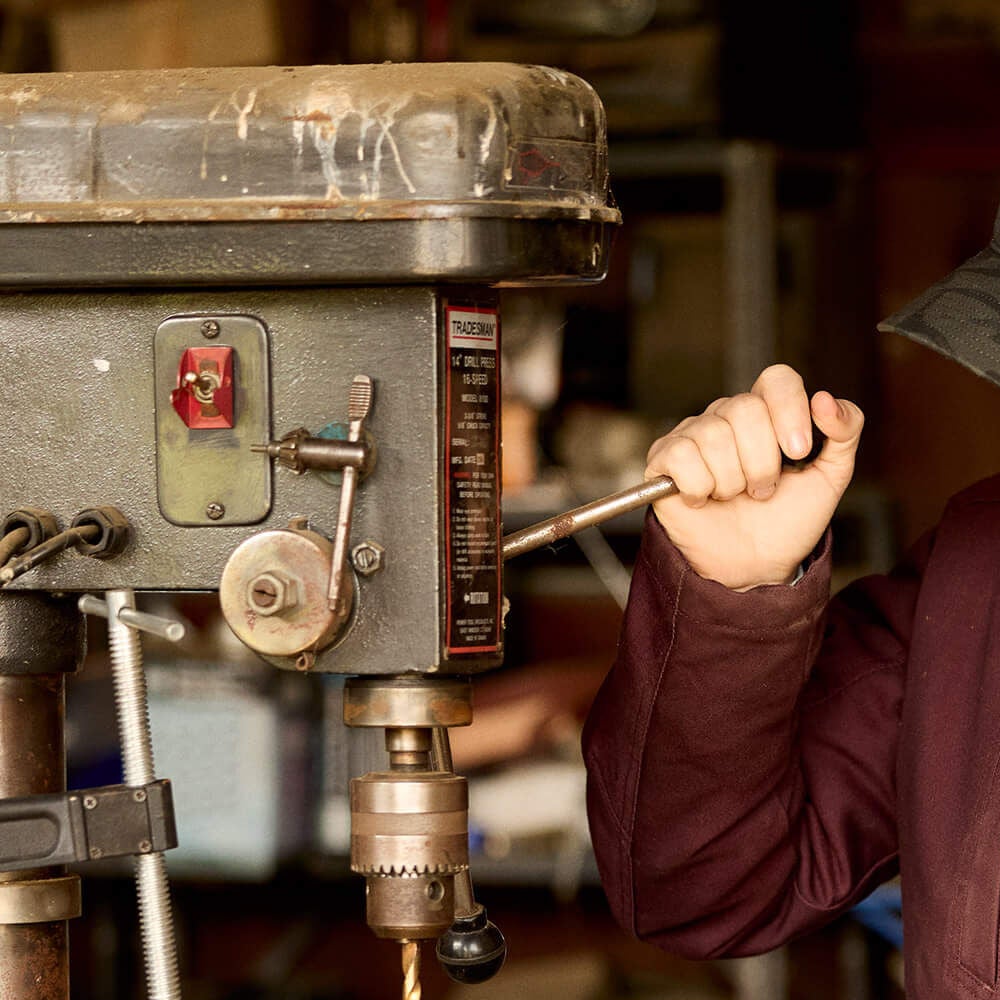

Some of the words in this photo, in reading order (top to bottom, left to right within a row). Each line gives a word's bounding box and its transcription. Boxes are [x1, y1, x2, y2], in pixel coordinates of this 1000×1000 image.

[452, 320, 494, 336] TRADESMAN
[464, 355, 480, 368] DRILL
[480, 356, 496, 369] PRESS
[463, 373, 489, 385] 16-SPEED
